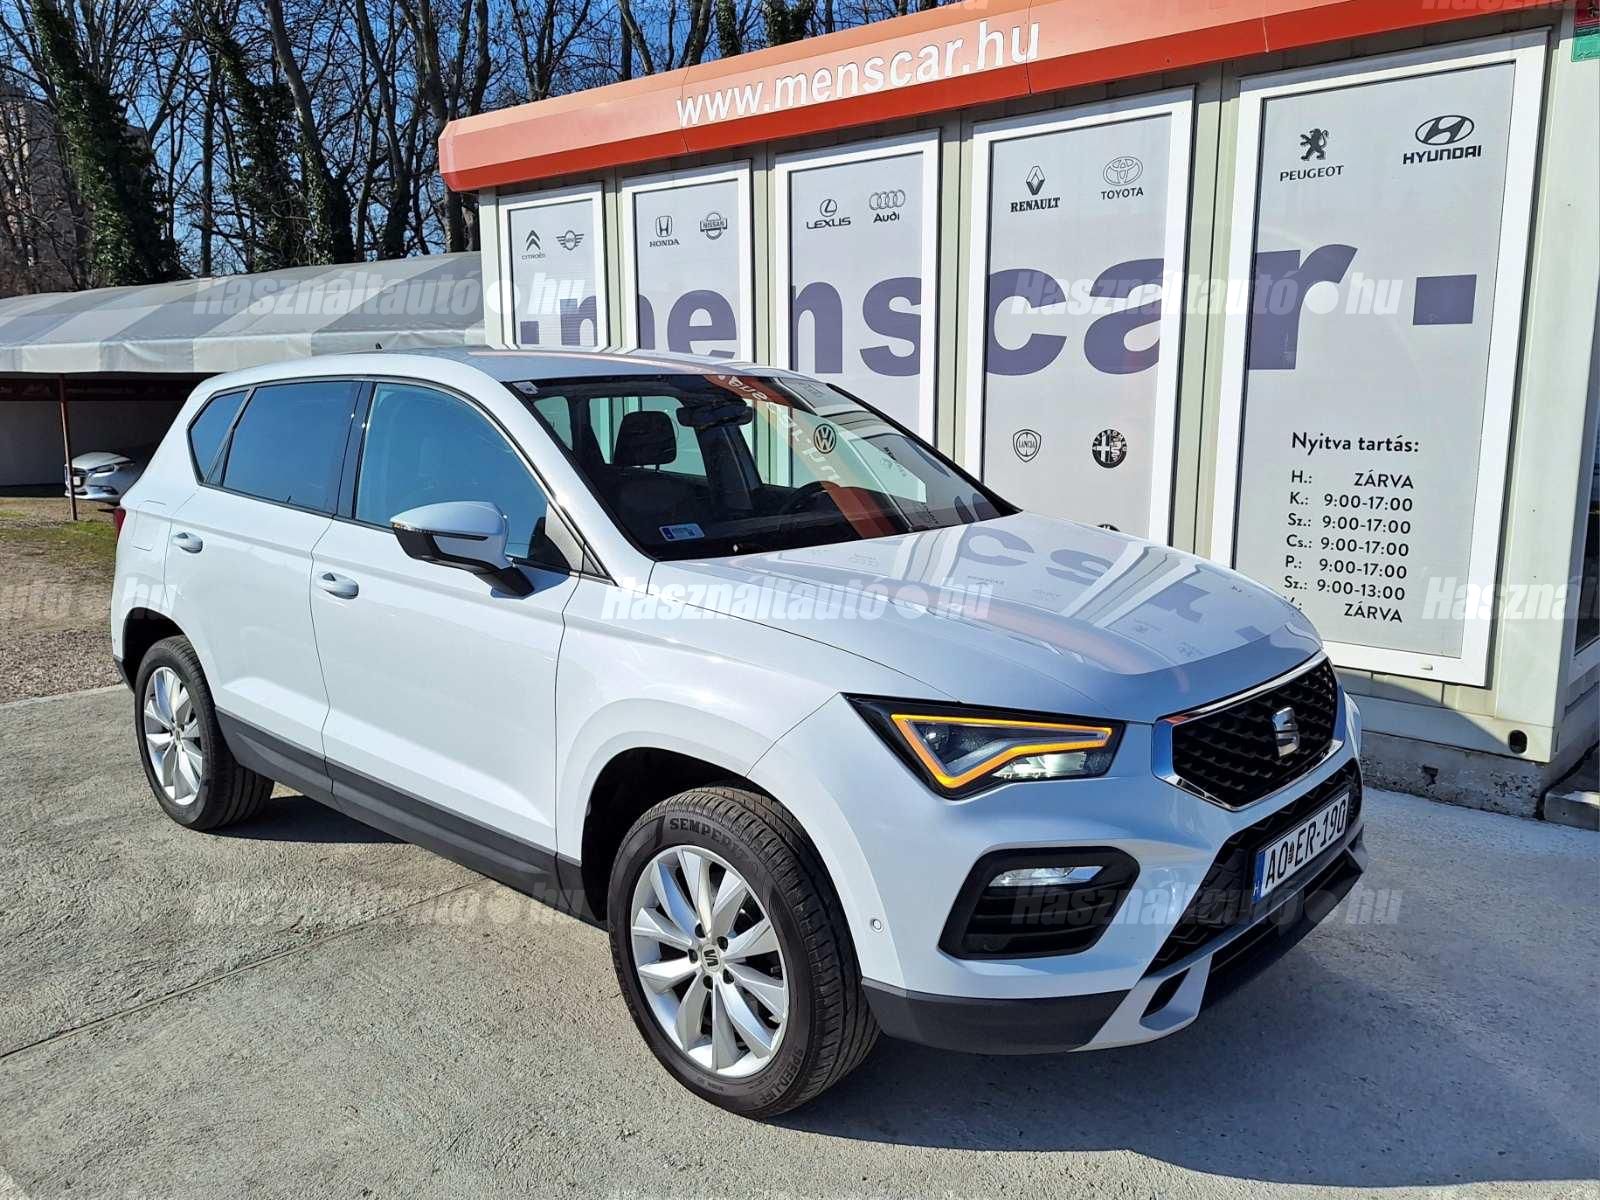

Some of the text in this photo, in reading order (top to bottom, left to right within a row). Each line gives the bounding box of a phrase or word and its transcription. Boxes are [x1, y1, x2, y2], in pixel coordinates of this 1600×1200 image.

[676, 21, 1040, 127] www.menscar.hu
[1403, 145, 1482, 165] HYUNDAI
[1280, 165, 1344, 182] PEUGEOT
[1101, 187, 1145, 200] TOYOTA
[1010, 197, 1061, 213] RENAULT
[806, 216, 851, 230] LEXUS
[873, 211, 900, 223] Audi
[649, 238, 680, 248] HONDA
[1292, 432, 1419, 456] Nyitva tartás:
[1291, 469, 1414, 489] H.: ZÁRVA
[1289, 491, 1413, 512] K.: 9:00-17:00
[1287, 512, 1411, 534] Sz.: 9:00-17:00
[1286, 534, 1409, 557] Cs.: 9:00-17:00
[1285, 555, 1407, 579] P.: 9:00-17:00
[1284, 575, 1405, 601] Sz.: 9:00-13:00
[1344, 600, 1402, 623] ZÁRVA
[1265, 840, 1289, 889] AO
